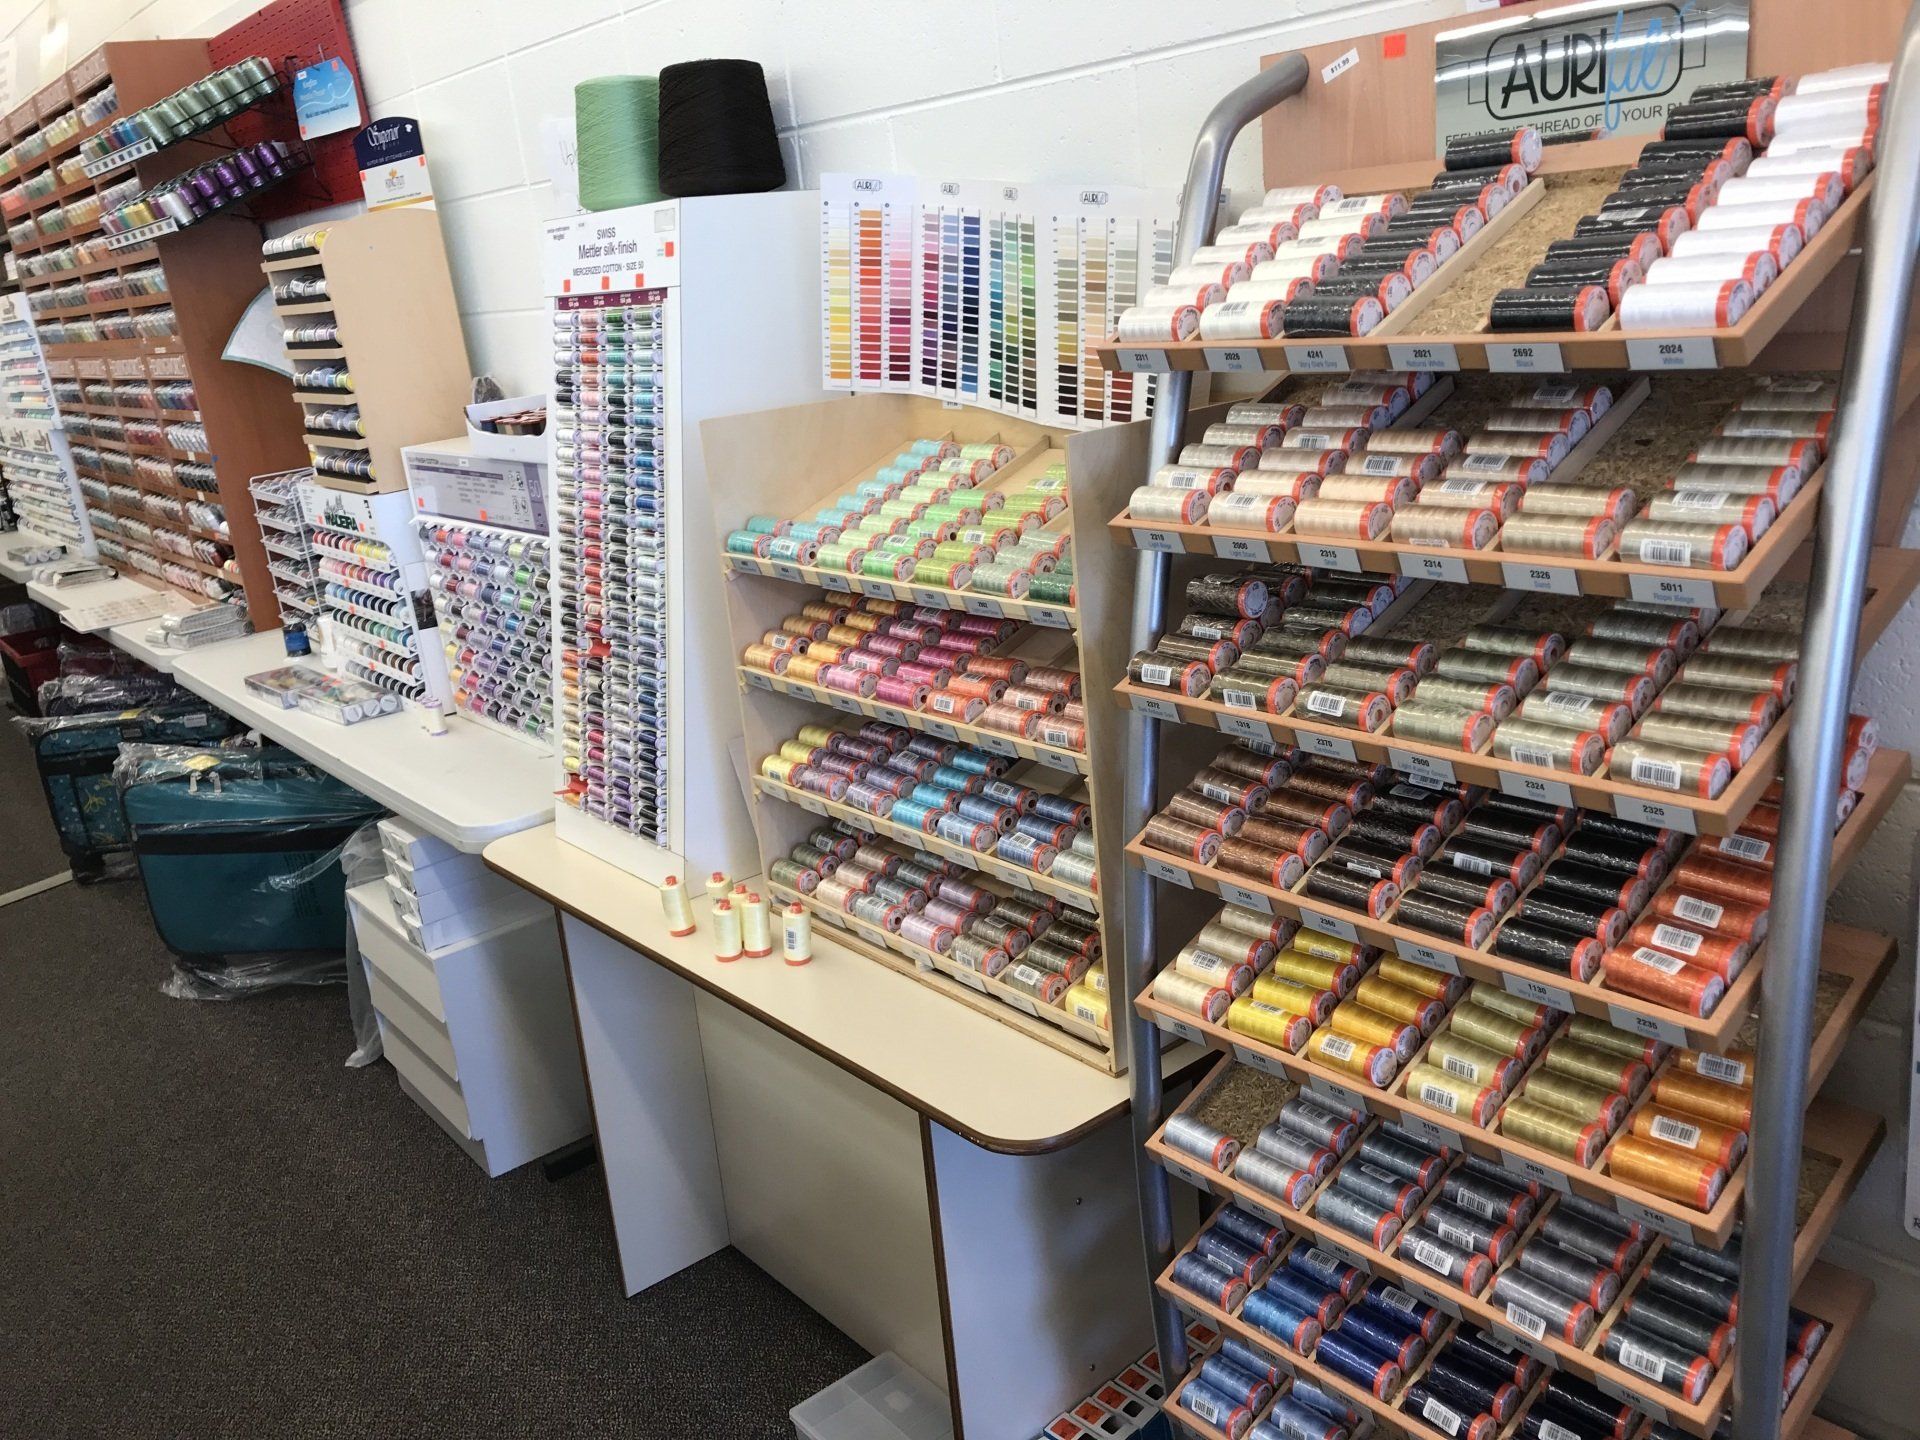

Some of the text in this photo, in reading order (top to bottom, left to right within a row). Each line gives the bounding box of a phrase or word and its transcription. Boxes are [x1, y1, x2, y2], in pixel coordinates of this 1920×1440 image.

[1584, 114, 1603, 127] OF
[1621, 105, 1663, 122] YOUR
[596, 227, 616, 240] SWISS
[578, 240, 638, 260] Mettler silk-finish
[572, 265, 601, 277] MERCERIZED
[602, 263, 622, 273] COTTON
[626, 261, 637, 271] SIZE
[1307, 350, 1323, 359] 4241
[1413, 349, 1432, 358] 2021
[1512, 348, 1534, 357] 2692
[1659, 344, 1683, 354] 2024
[1319, 549, 1337, 559] 2315
[1423, 559, 1442, 569] 2314
[1529, 569, 1551, 580] 2326
[1660, 582, 1683, 593] 5011
[1524, 780, 1545, 791] 2324
[1642, 805, 1665, 816] 2325
[1636, 1017, 1658, 1030] 2235
